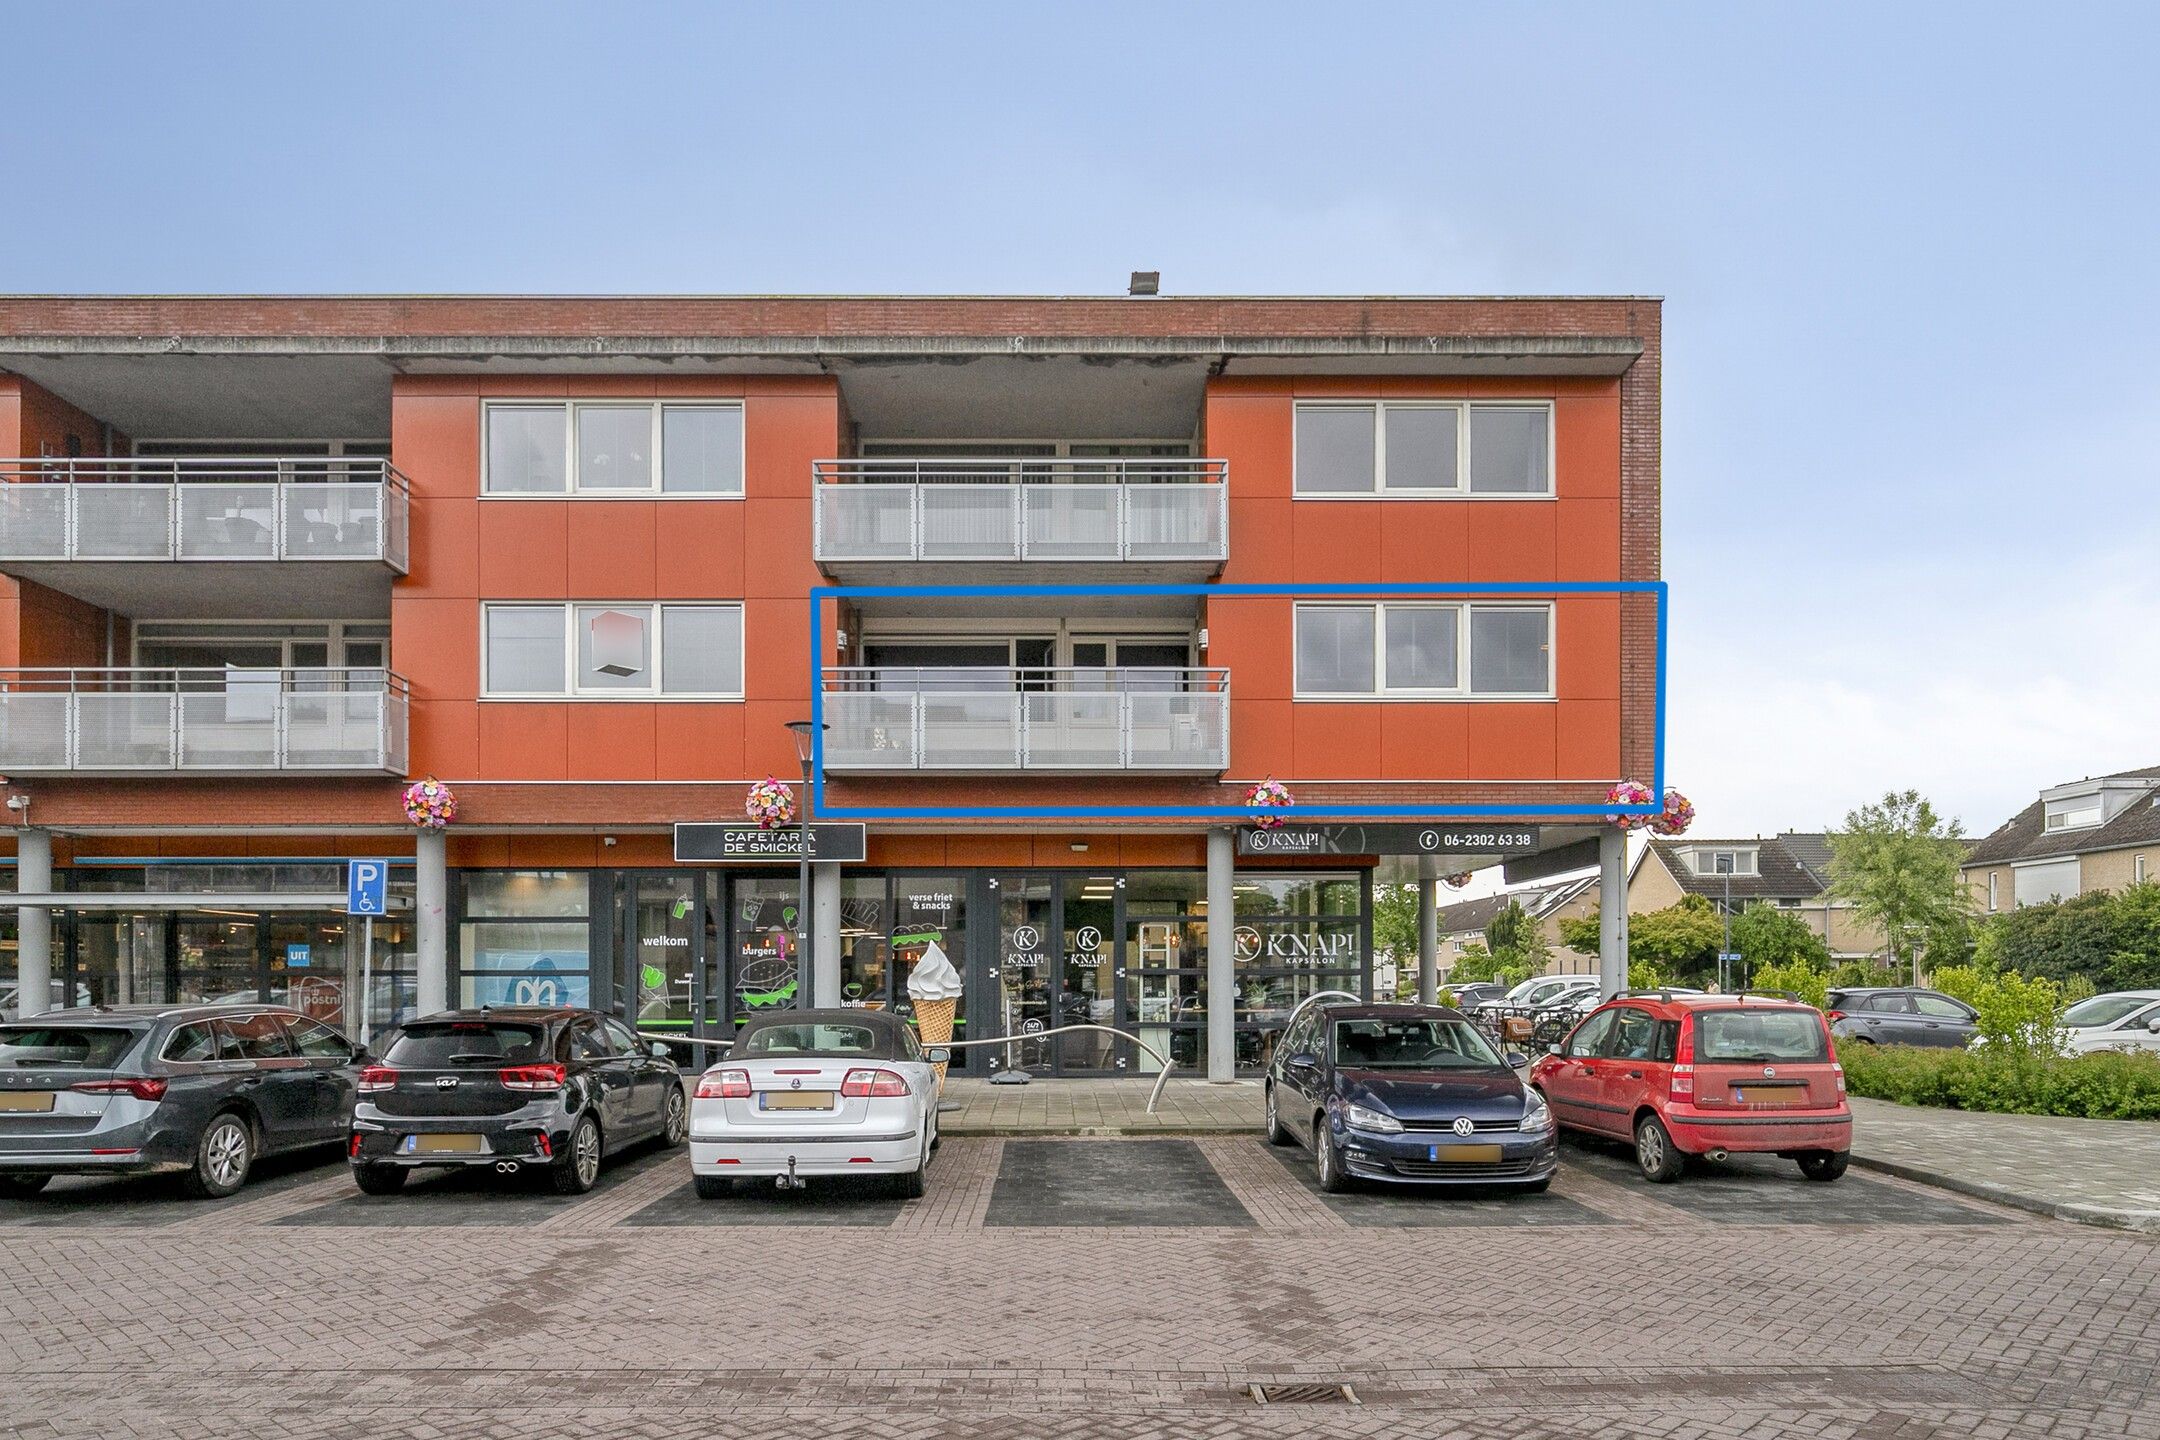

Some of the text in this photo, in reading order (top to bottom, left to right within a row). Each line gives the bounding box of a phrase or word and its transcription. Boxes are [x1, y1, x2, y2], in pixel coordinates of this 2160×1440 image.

[723, 832, 816, 842] CAFETARA
[1272, 833, 1319, 846] KNAP!
[1444, 834, 1531, 846] 06-2302 63 38
[723, 843, 746, 853] DE
[357, 864, 378, 892] P
[779, 891, 790, 902] ijs
[908, 892, 953, 902] verse friet
[912, 901, 951, 910] & snacks
[642, 935, 689, 946] welkom
[1266, 933, 1354, 956] KNAP!
[290, 951, 308, 960] UIT
[742, 946, 777, 958] burgers
[1007, 953, 1044, 964] KNAP!
[1070, 953, 1107, 965] KNAP!
[303, 994, 341, 1007] postnl
[840, 999, 866, 1008] koffie
